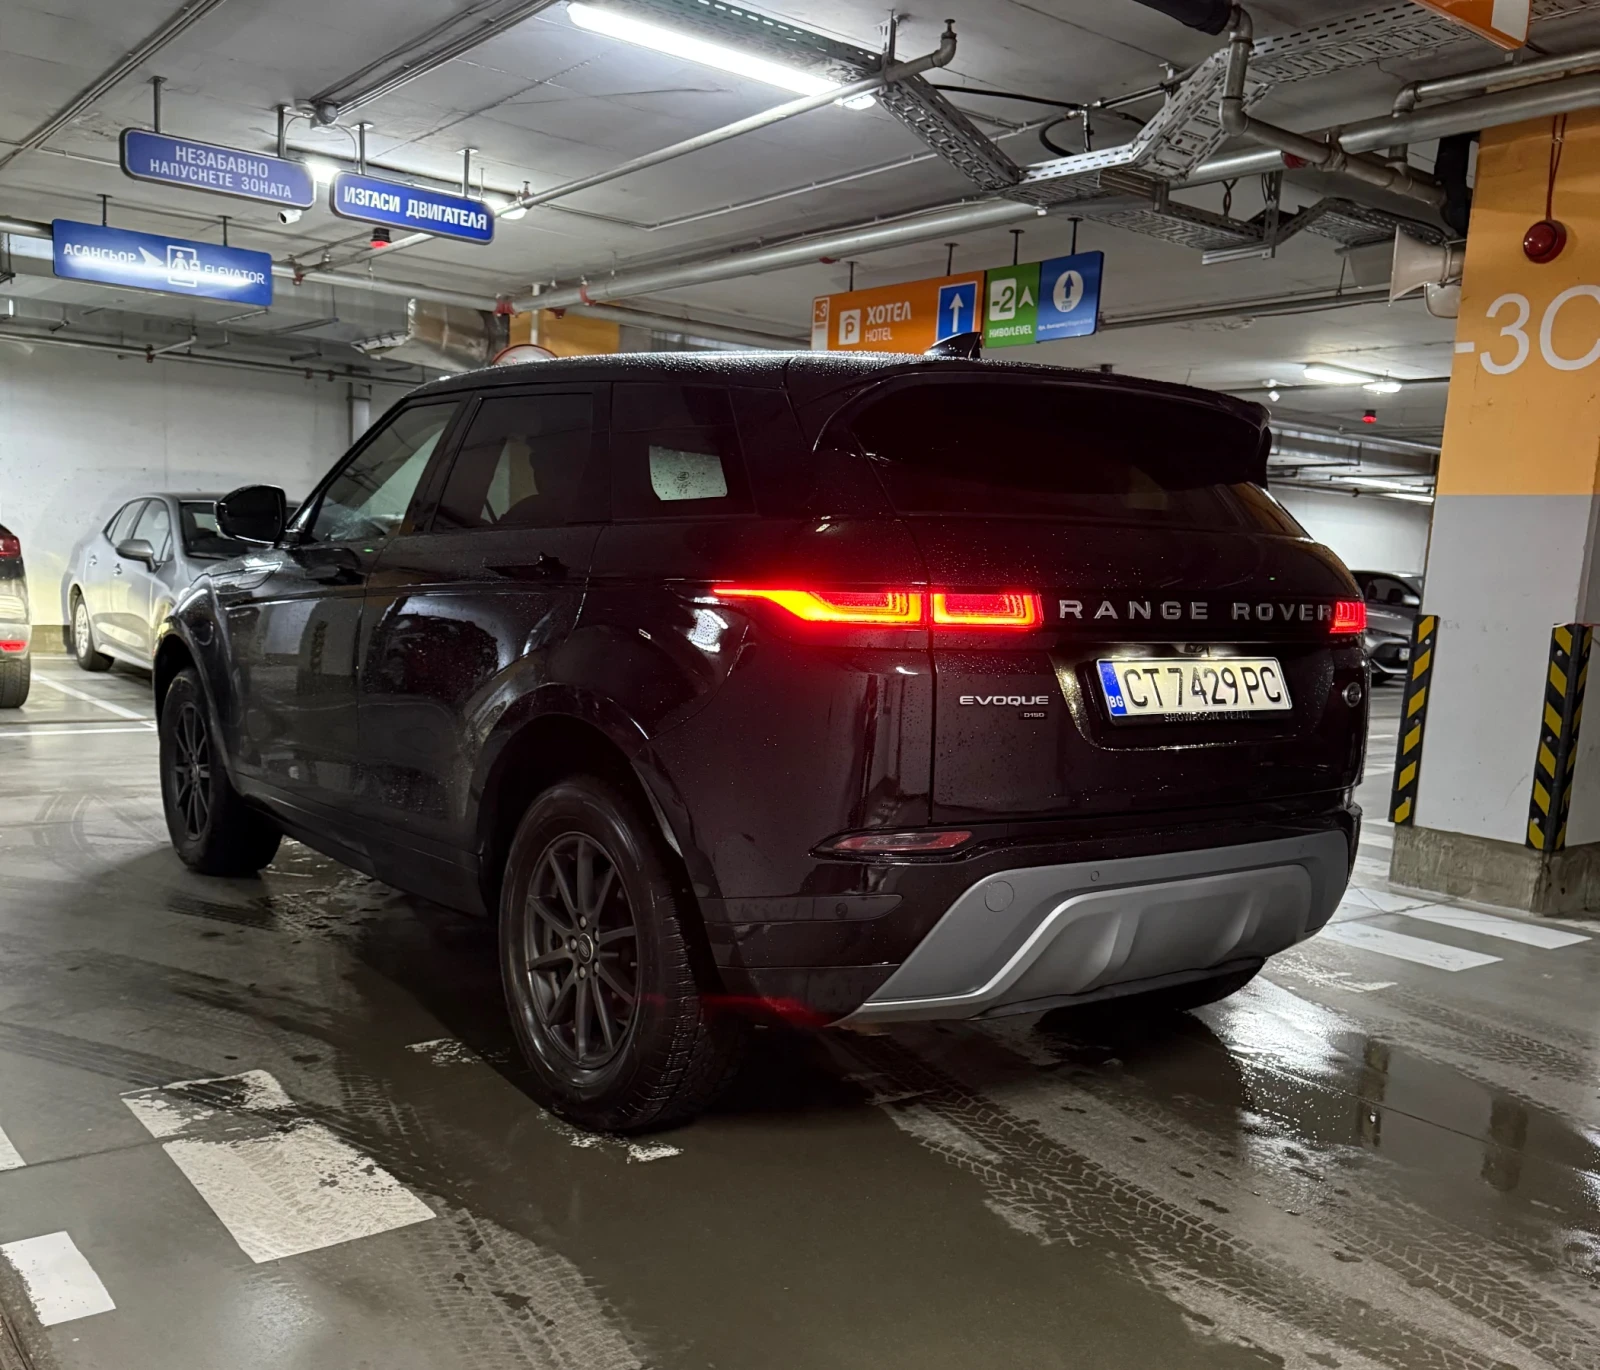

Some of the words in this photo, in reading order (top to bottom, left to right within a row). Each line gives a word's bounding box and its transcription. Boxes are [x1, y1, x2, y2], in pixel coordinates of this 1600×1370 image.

[175, 145, 269, 179] НЕЗАБАВНО
[149, 158, 234, 187] НАПУСНЕТЕ
[241, 177, 292, 199] ЗОНАТА
[344, 185, 400, 213] ИЗГАСИ
[406, 198, 487, 231] ДВИГАТЕЛЯ
[63, 243, 137, 263] АСАНСЬОР
[815, 302, 827, 317] -3
[992, 285, 1015, 313] -2
[866, 301, 912, 325] ХОТЕЛ
[864, 327, 893, 343] HOTEL
[1058, 600, 1209, 620] RANGE
[1231, 602, 1332, 621] ROVER
[959, 695, 1049, 706] EVOQUE
[1108, 695, 1124, 708] BG
